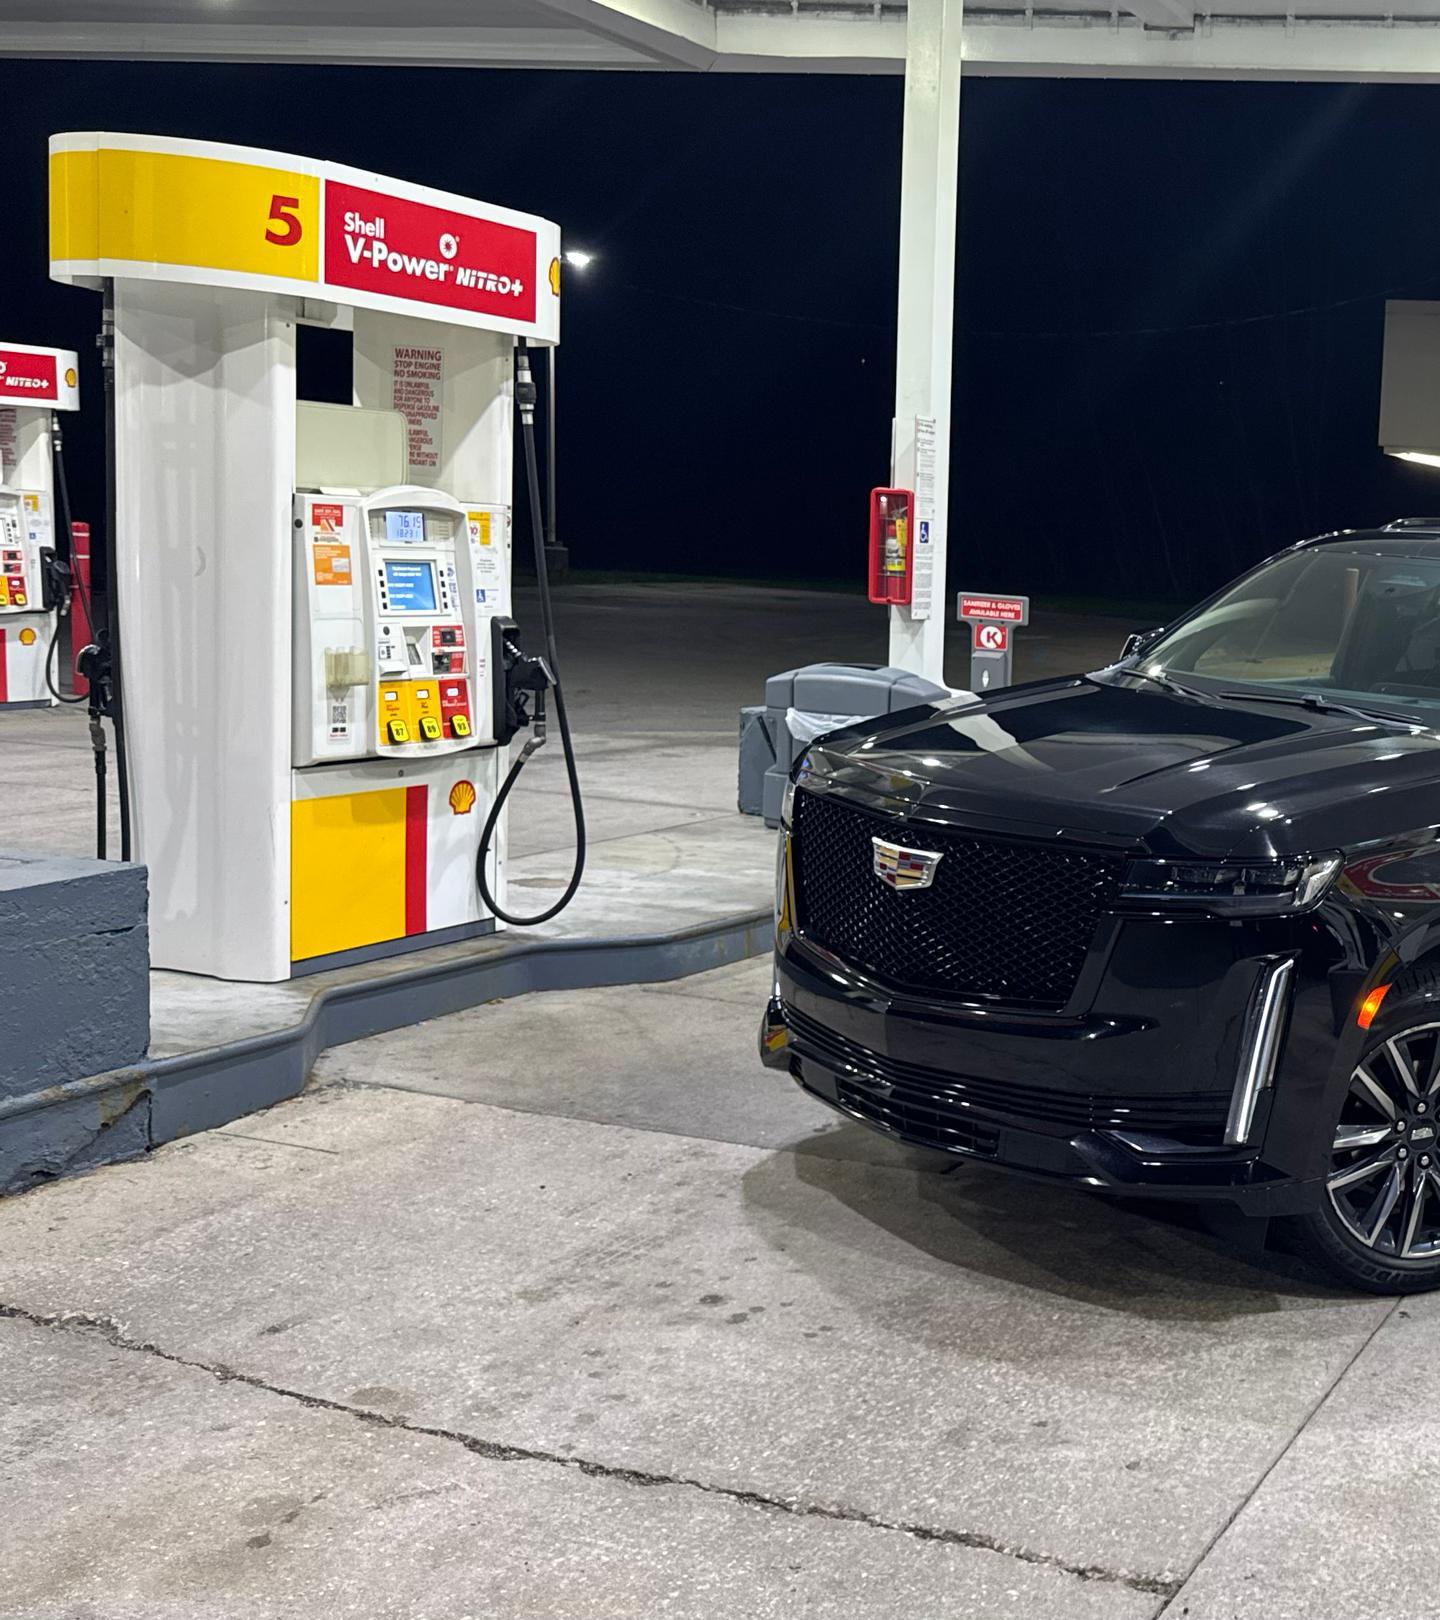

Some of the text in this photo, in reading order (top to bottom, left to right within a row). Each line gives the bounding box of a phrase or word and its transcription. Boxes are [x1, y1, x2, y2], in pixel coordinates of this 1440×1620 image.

[265, 194, 302, 246] 5
[343, 212, 385, 239] Shell
[344, 233, 449, 282] V-Power
[394, 348, 442, 360] WARNING
[394, 360, 441, 371] STOP ENGINE
[393, 369, 441, 380] NO SMOKING
[416, 403, 440, 412] GASOLINE
[394, 727, 404, 736] 87
[426, 724, 437, 733] 89
[457, 722, 467, 731] 93
